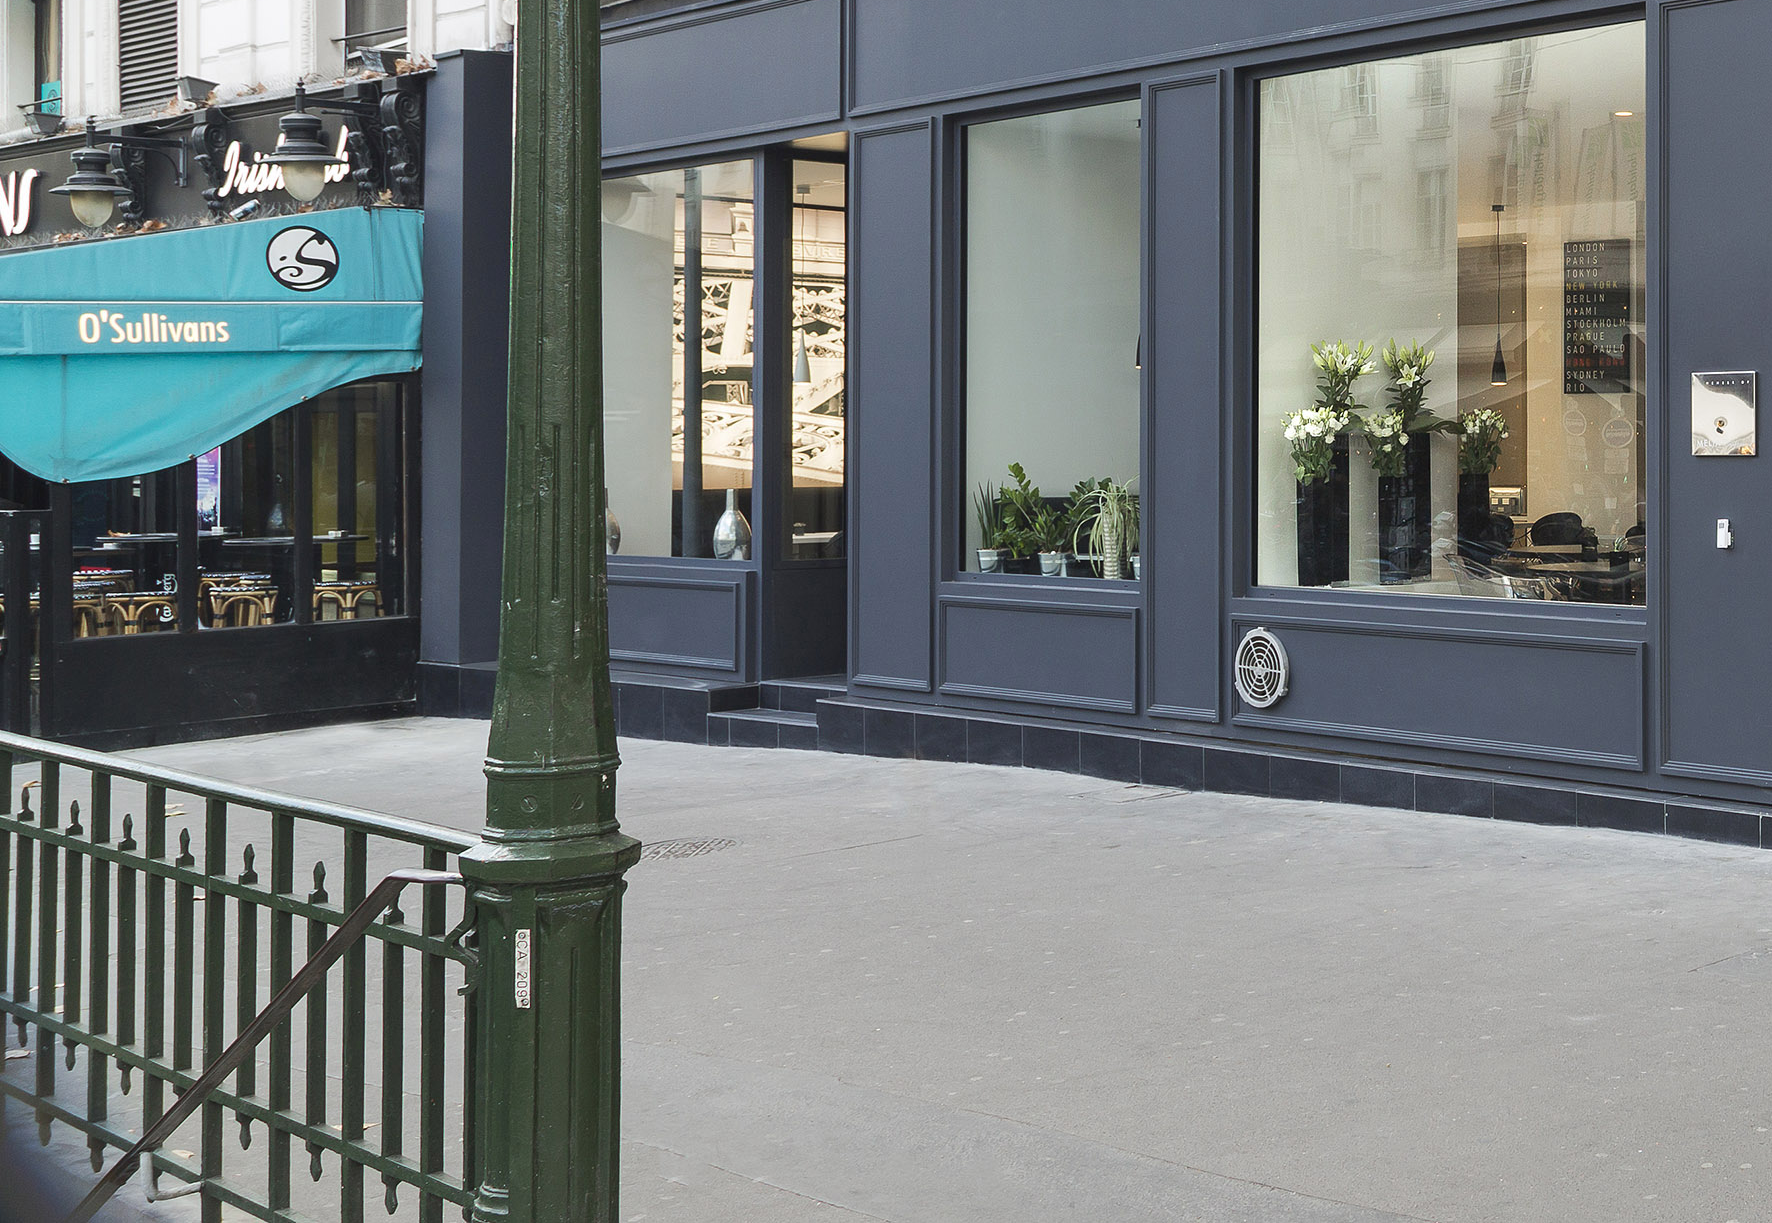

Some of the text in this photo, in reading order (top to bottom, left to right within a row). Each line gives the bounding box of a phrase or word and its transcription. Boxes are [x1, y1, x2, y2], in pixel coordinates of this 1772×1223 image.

[1566, 243, 1605, 253] LONDON
[1566, 256, 1598, 265] PARIS
[1566, 268, 1598, 278] TOKYO
[1566, 280, 1618, 290] NEW YORK
[1566, 294, 1605, 304] BERLIN
[1565, 307, 1597, 316] MIAMI
[79, 309, 230, 344] O'Sullivans
[1566, 318, 1626, 329] STOCKHOLM
[1566, 331, 1605, 341] PRAGUE
[1566, 343, 1625, 354] SAO PAULO
[1566, 370, 1605, 380] SYDNEY
[1566, 383, 1585, 392] RIO
[516, 940, 528, 998] CA 209
